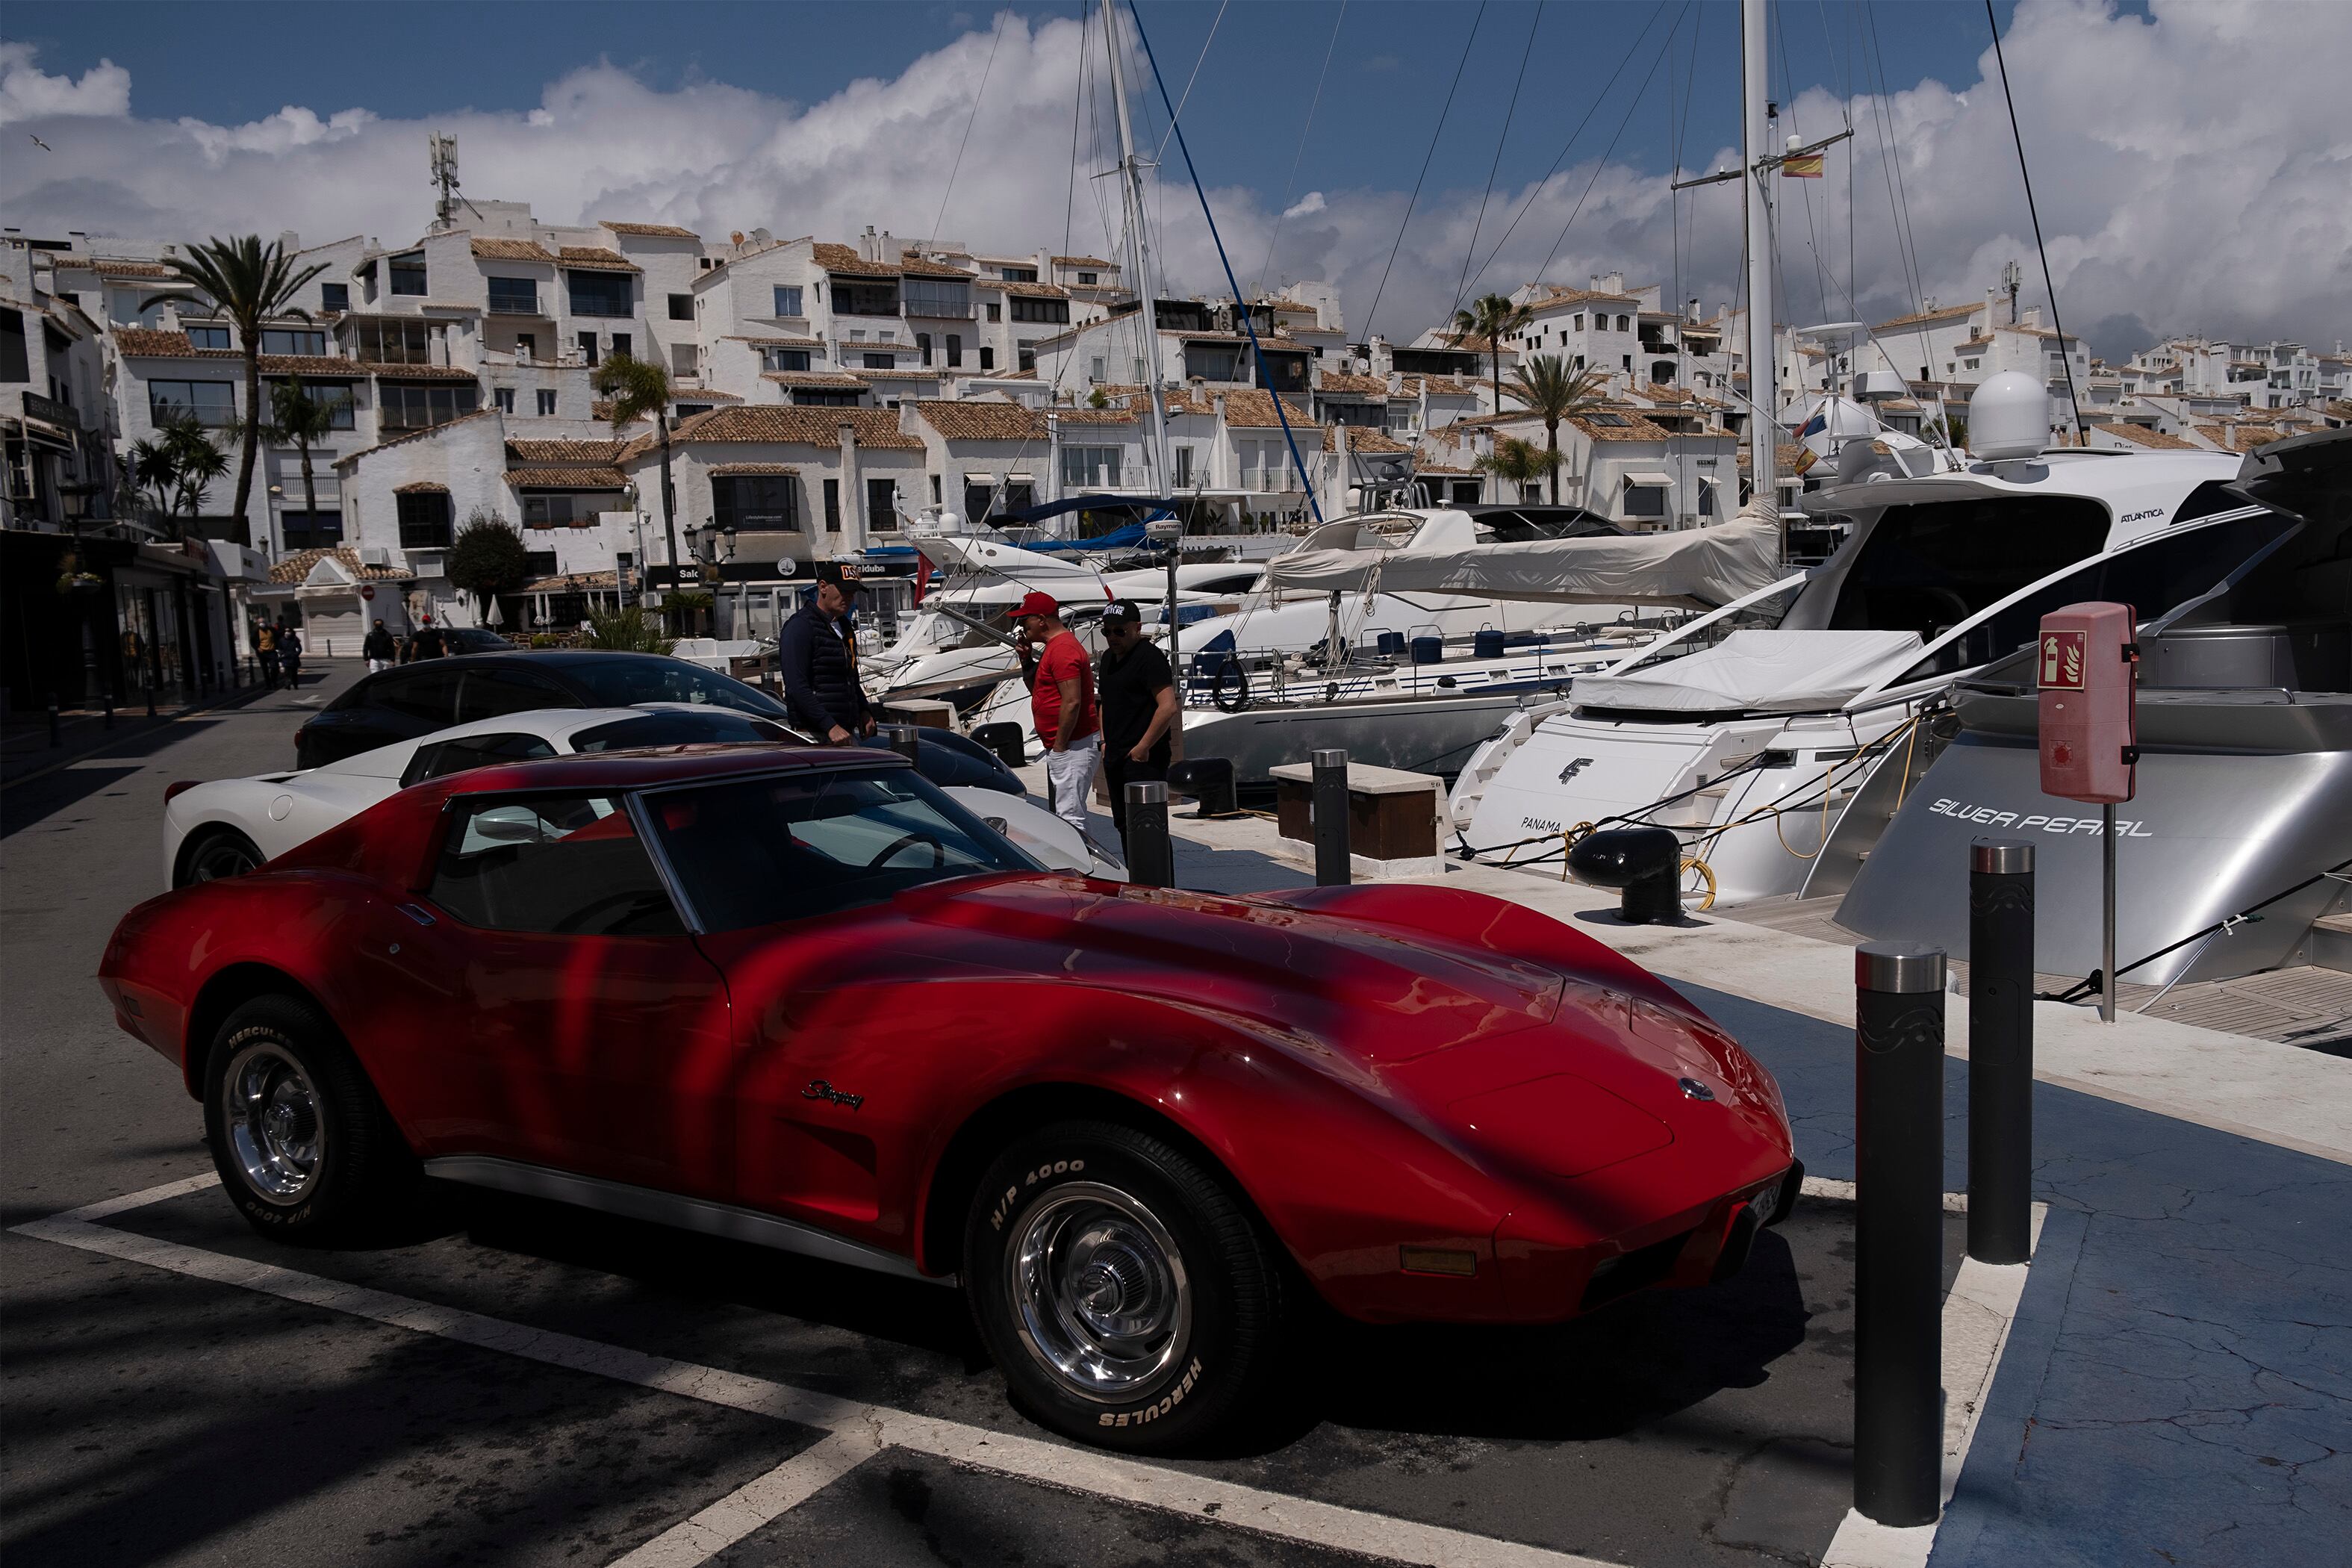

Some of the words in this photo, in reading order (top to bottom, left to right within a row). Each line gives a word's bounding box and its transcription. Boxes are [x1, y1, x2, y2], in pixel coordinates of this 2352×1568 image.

[2121, 508, 2165, 523] ATLANTICA
[1521, 817, 1561, 833] PANAMA
[1929, 797, 2019, 828] SILVER
[2016, 815, 2153, 837] PEARL
[991, 1186, 1017, 1231] H/P
[1025, 1160, 1085, 1186] 4000
[246, 1201, 283, 1224] 4000
[287, 1204, 311, 1224] H/P
[1098, 1355, 1202, 1428] HERCULES
